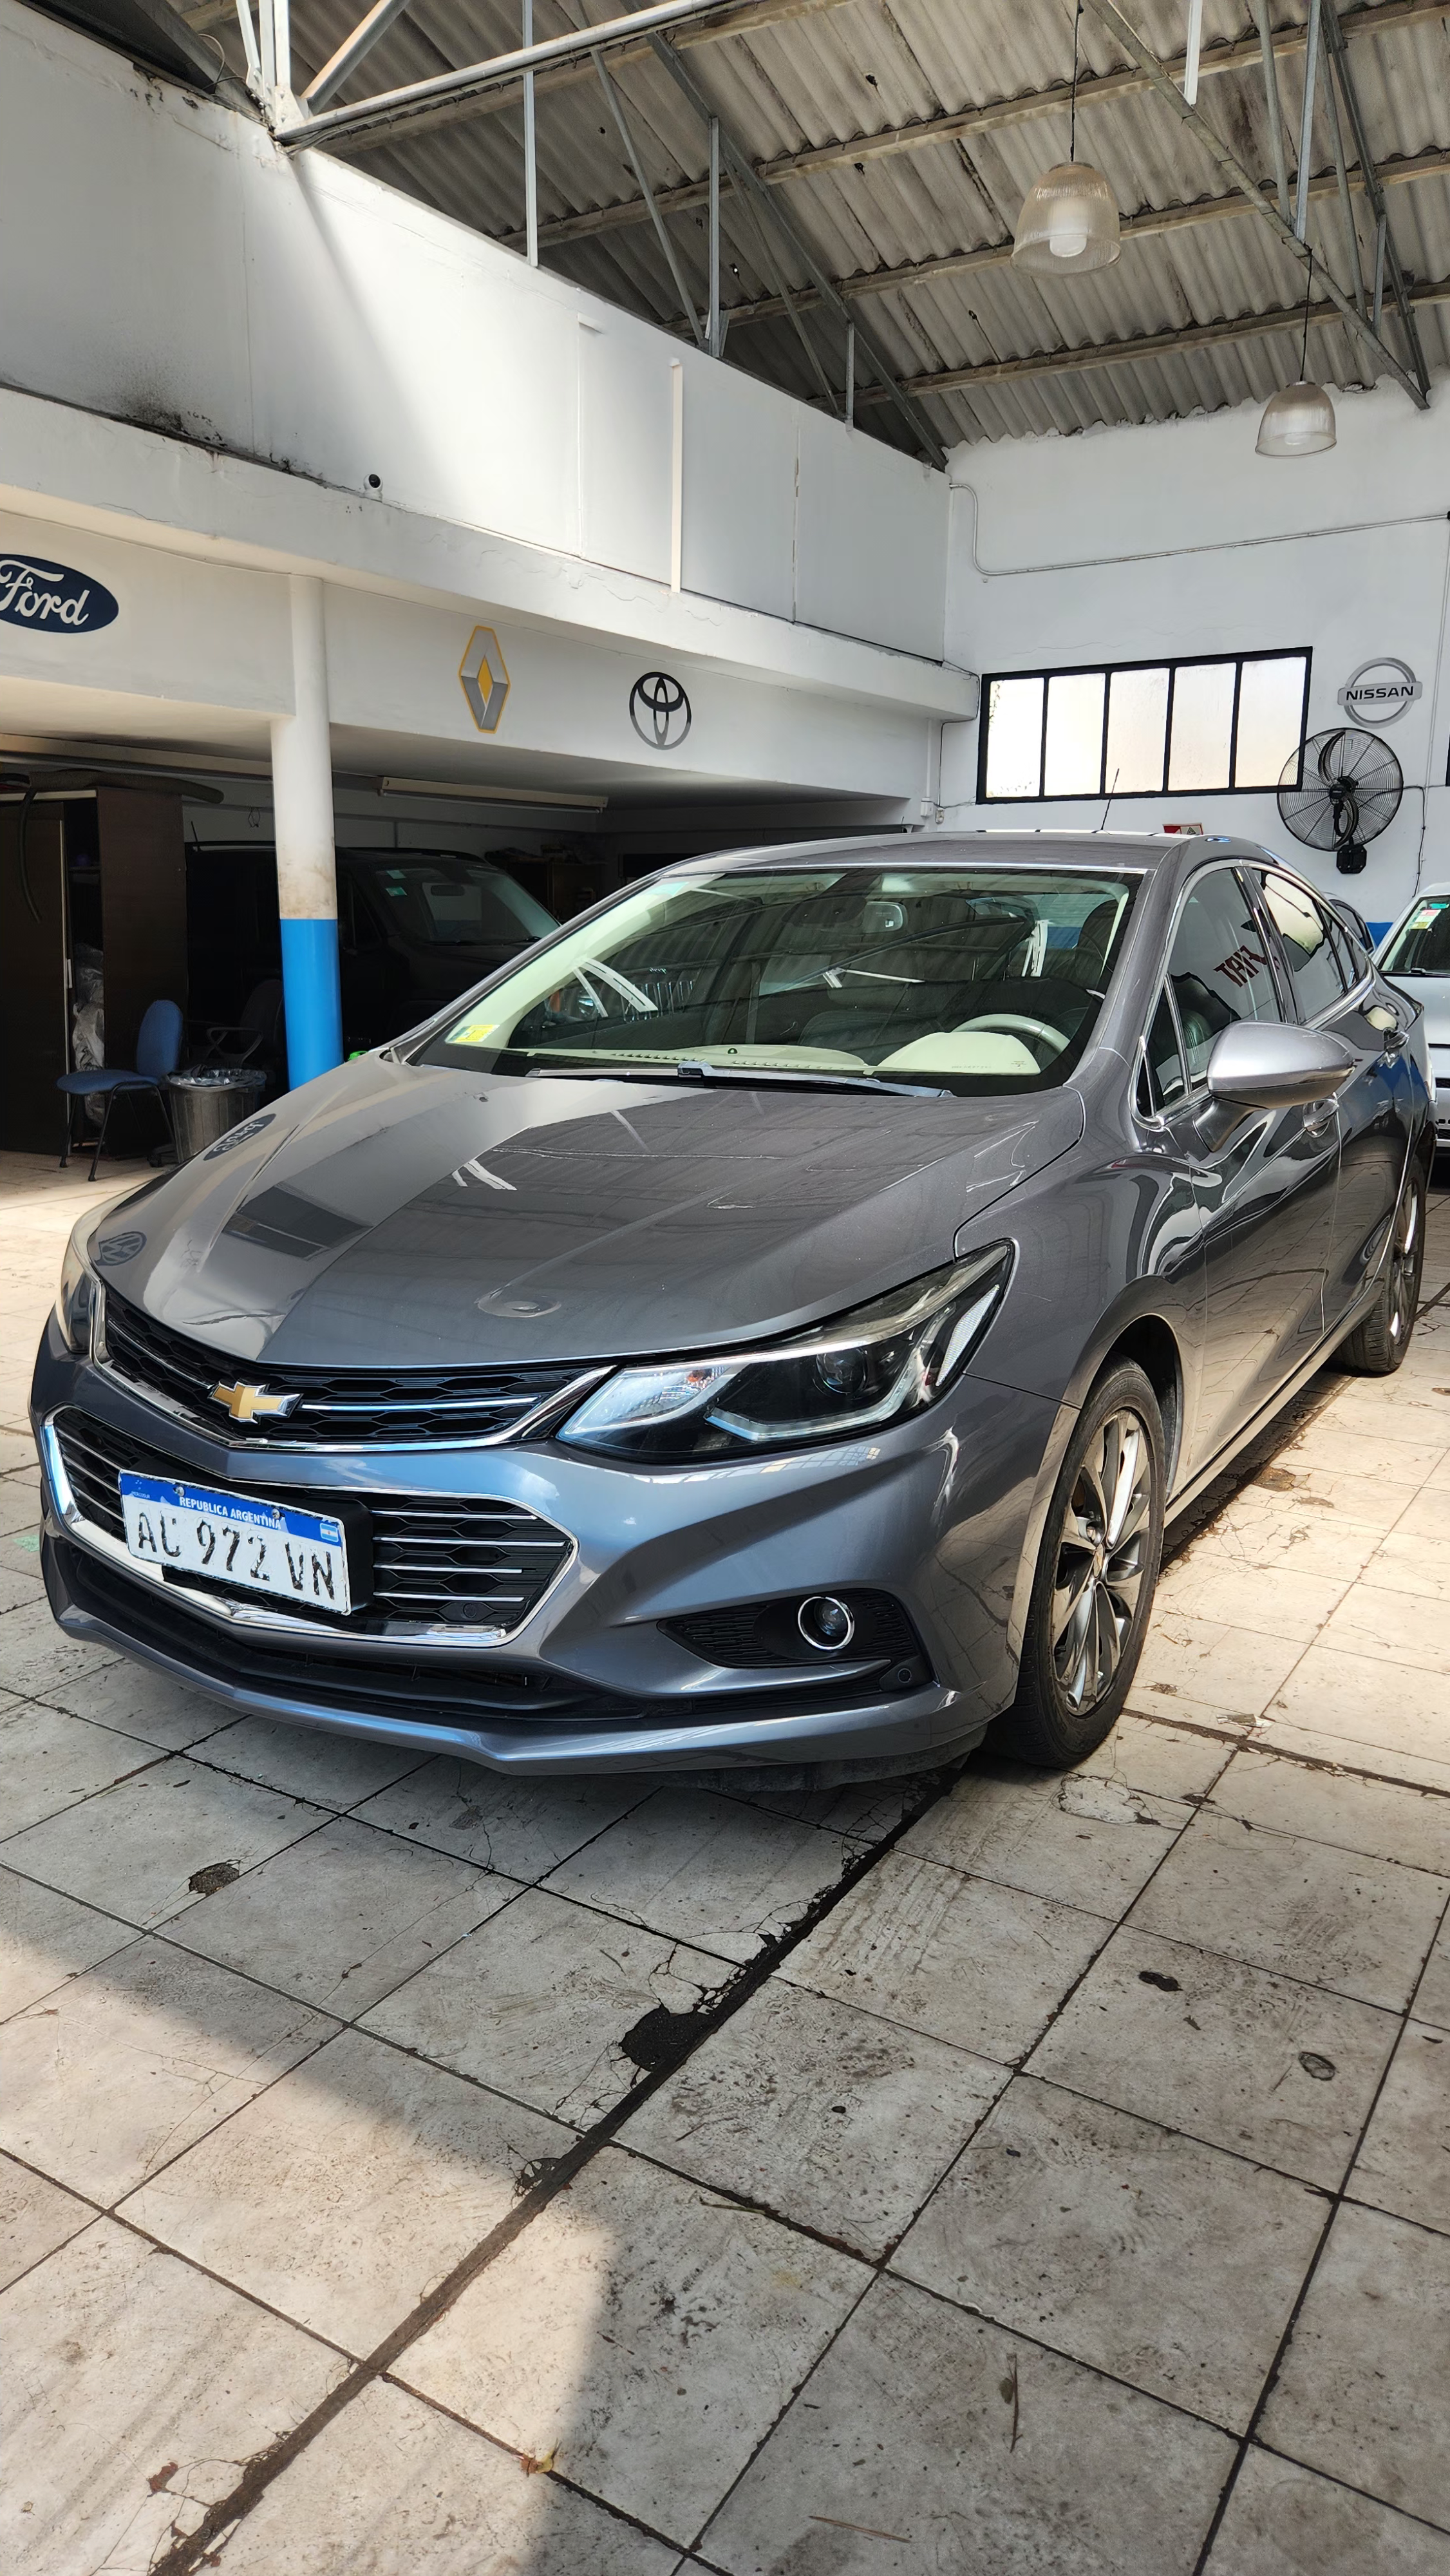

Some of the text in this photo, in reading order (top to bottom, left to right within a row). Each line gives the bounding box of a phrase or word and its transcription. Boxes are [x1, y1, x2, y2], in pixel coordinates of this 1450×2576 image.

[0, 560, 89, 625] Ford
[1346, 686, 1414, 701] NISSAN
[180, 1497, 281, 1530] REPUBLICA ARGENTINA
[138, 1508, 335, 1600] AC 972 VN
